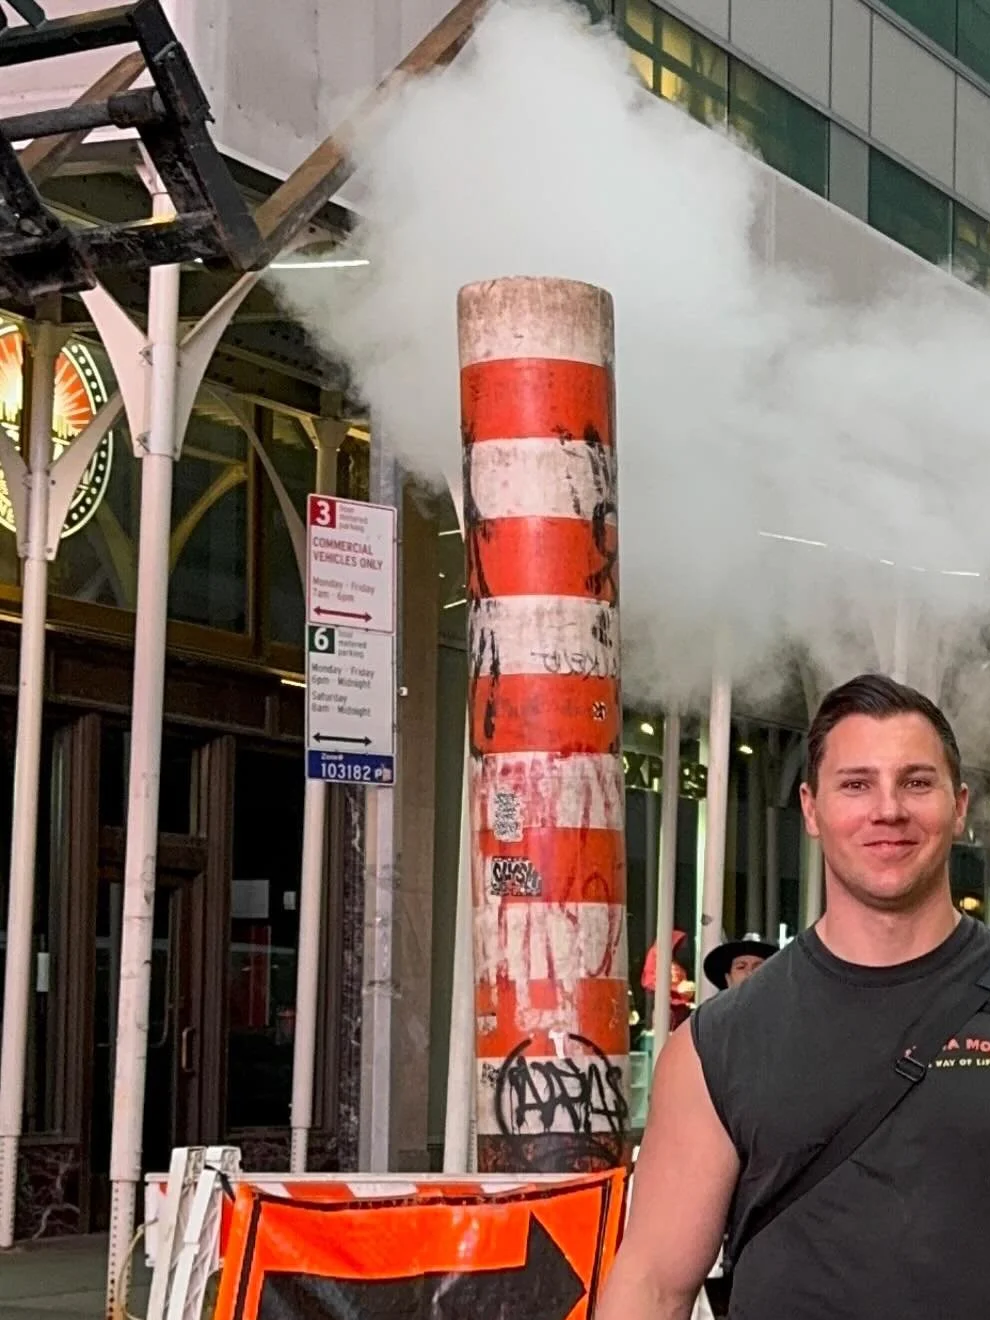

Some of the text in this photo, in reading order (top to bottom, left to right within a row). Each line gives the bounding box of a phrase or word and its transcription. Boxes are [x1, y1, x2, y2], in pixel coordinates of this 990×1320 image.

[316, 501, 331, 525] 3
[313, 536, 373, 555] COMMERCIAL
[313, 551, 383, 571] VEHICLES ONLY
[312, 575, 376, 594] Monday Friday
[314, 628, 329, 651] 6
[311, 663, 375, 679] Monday Friday
[337, 678, 371, 690] Midnight
[311, 690, 348, 704] Saturday
[337, 705, 371, 718] Midnight
[320, 762, 371, 780] 103182
[935, 1059, 955, 1068] WAY
[959, 1058, 972, 1067] OF
